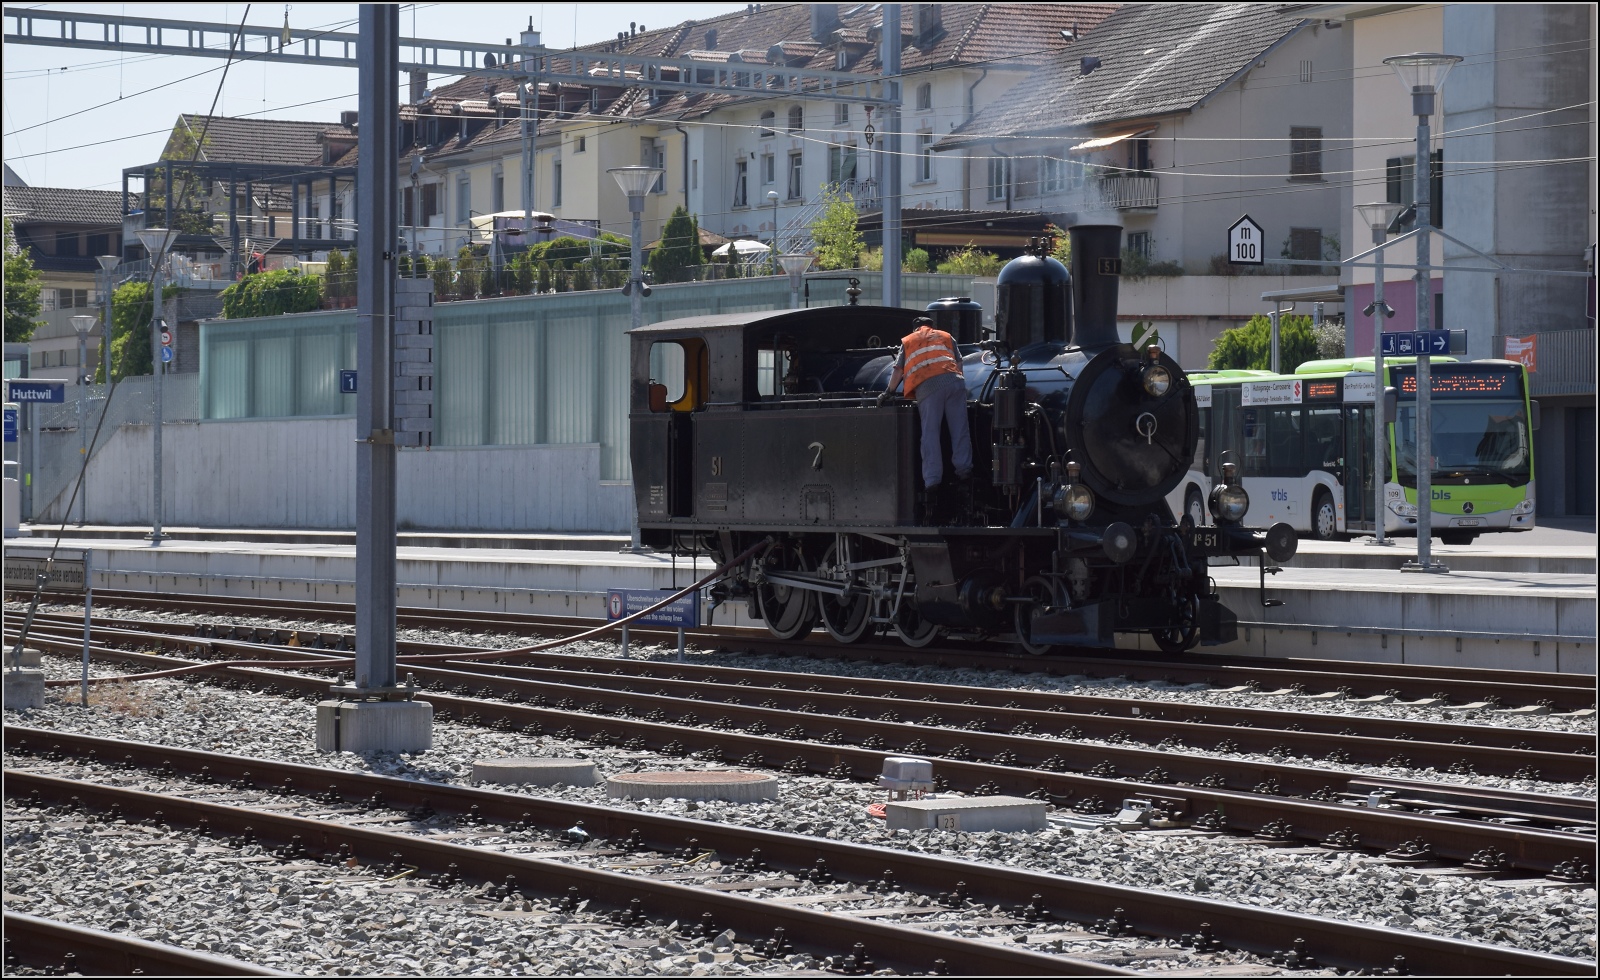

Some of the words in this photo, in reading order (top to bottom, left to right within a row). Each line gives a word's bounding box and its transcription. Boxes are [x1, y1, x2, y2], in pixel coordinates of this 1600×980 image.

[1241, 227, 1251, 239] m
[1236, 243, 1255, 259] 100
[1420, 338, 1424, 352] 1
[348, 378, 354, 390] 1
[12, 389, 52, 400] Huttwil
[711, 456, 722, 476] 51
[1278, 488, 1288, 500] bls
[1432, 489, 1451, 500] bls
[1204, 534, 1216, 546] 51
[944, 818, 954, 828] 23
